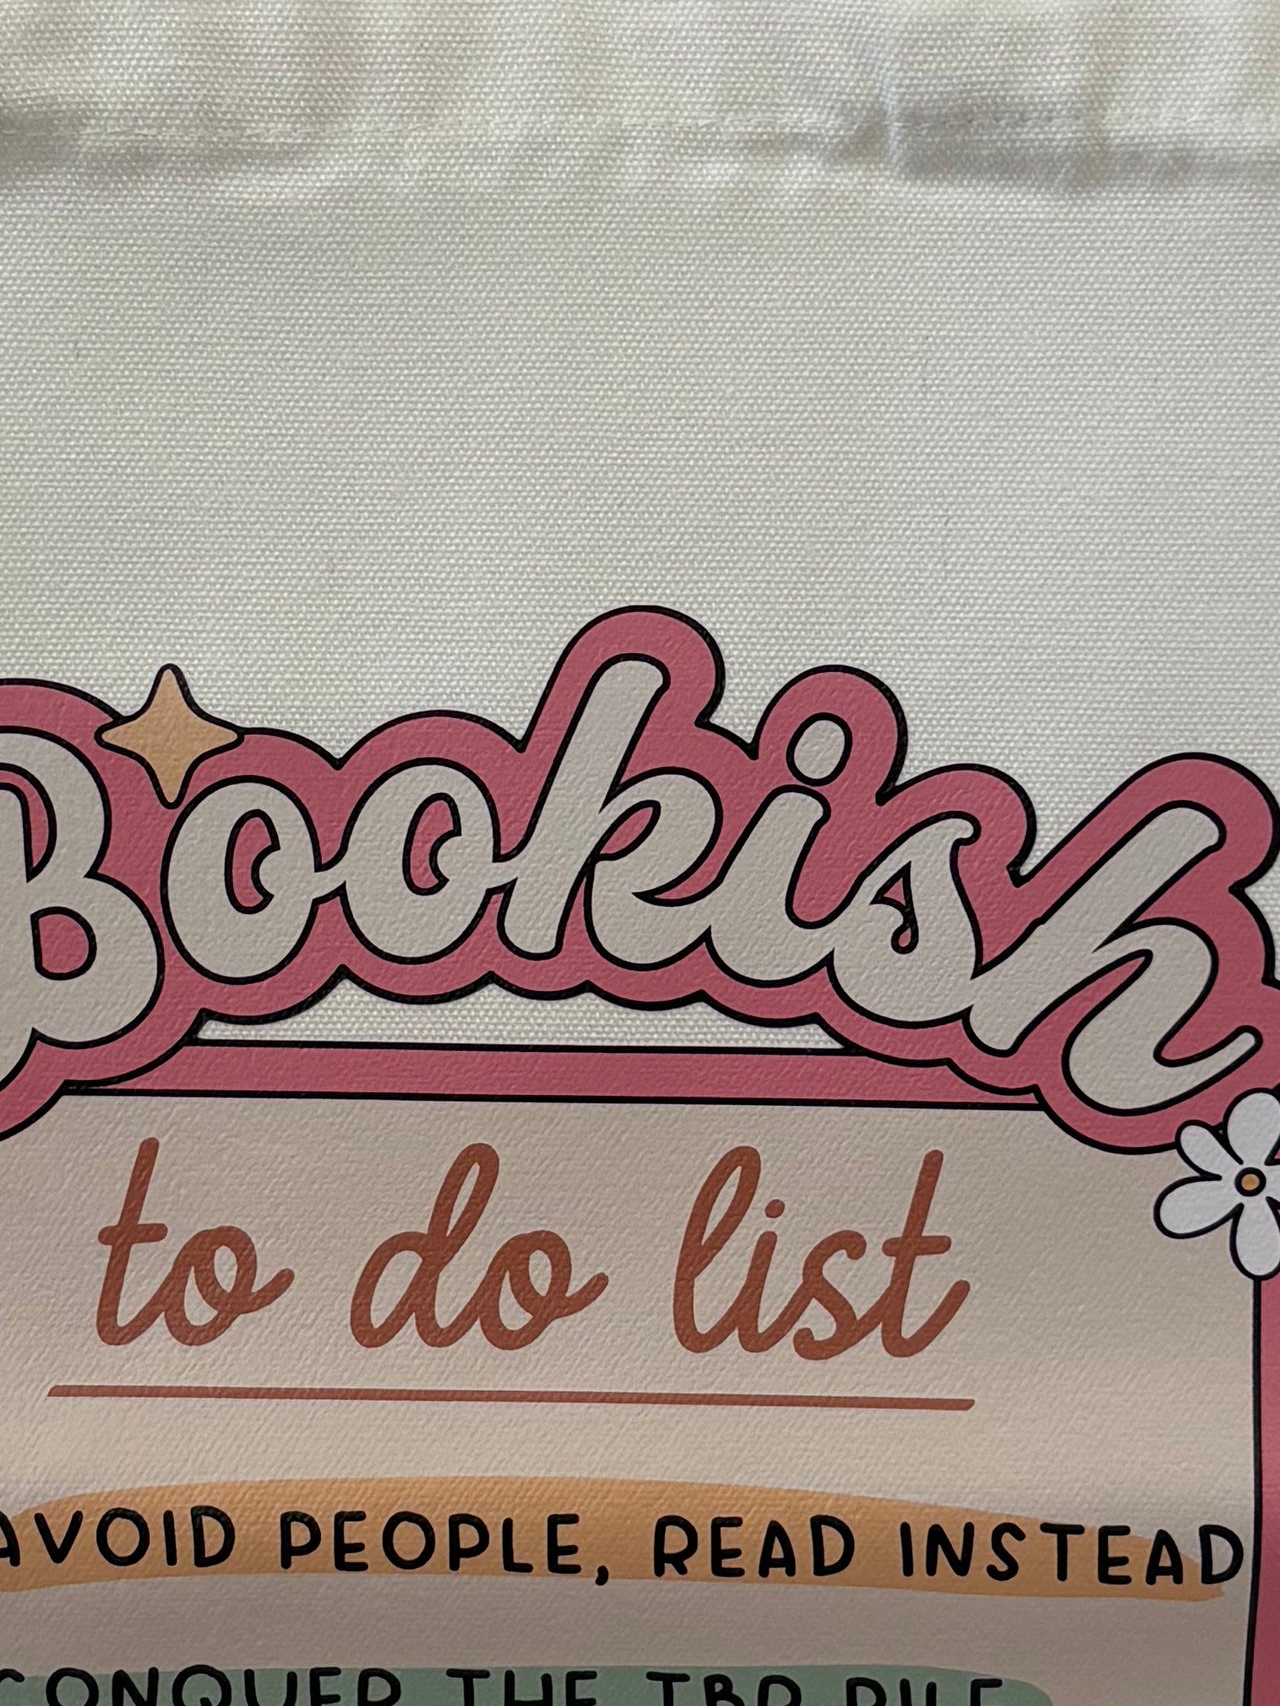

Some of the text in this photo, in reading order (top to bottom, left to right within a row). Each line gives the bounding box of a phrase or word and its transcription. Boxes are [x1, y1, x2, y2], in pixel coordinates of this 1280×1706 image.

[95, 1138, 970, 1362] to do list
[278, 1509, 610, 1588] PEOPLE,
[652, 1513, 856, 1580] READ
[898, 1521, 1246, 1587] INSTEAD
